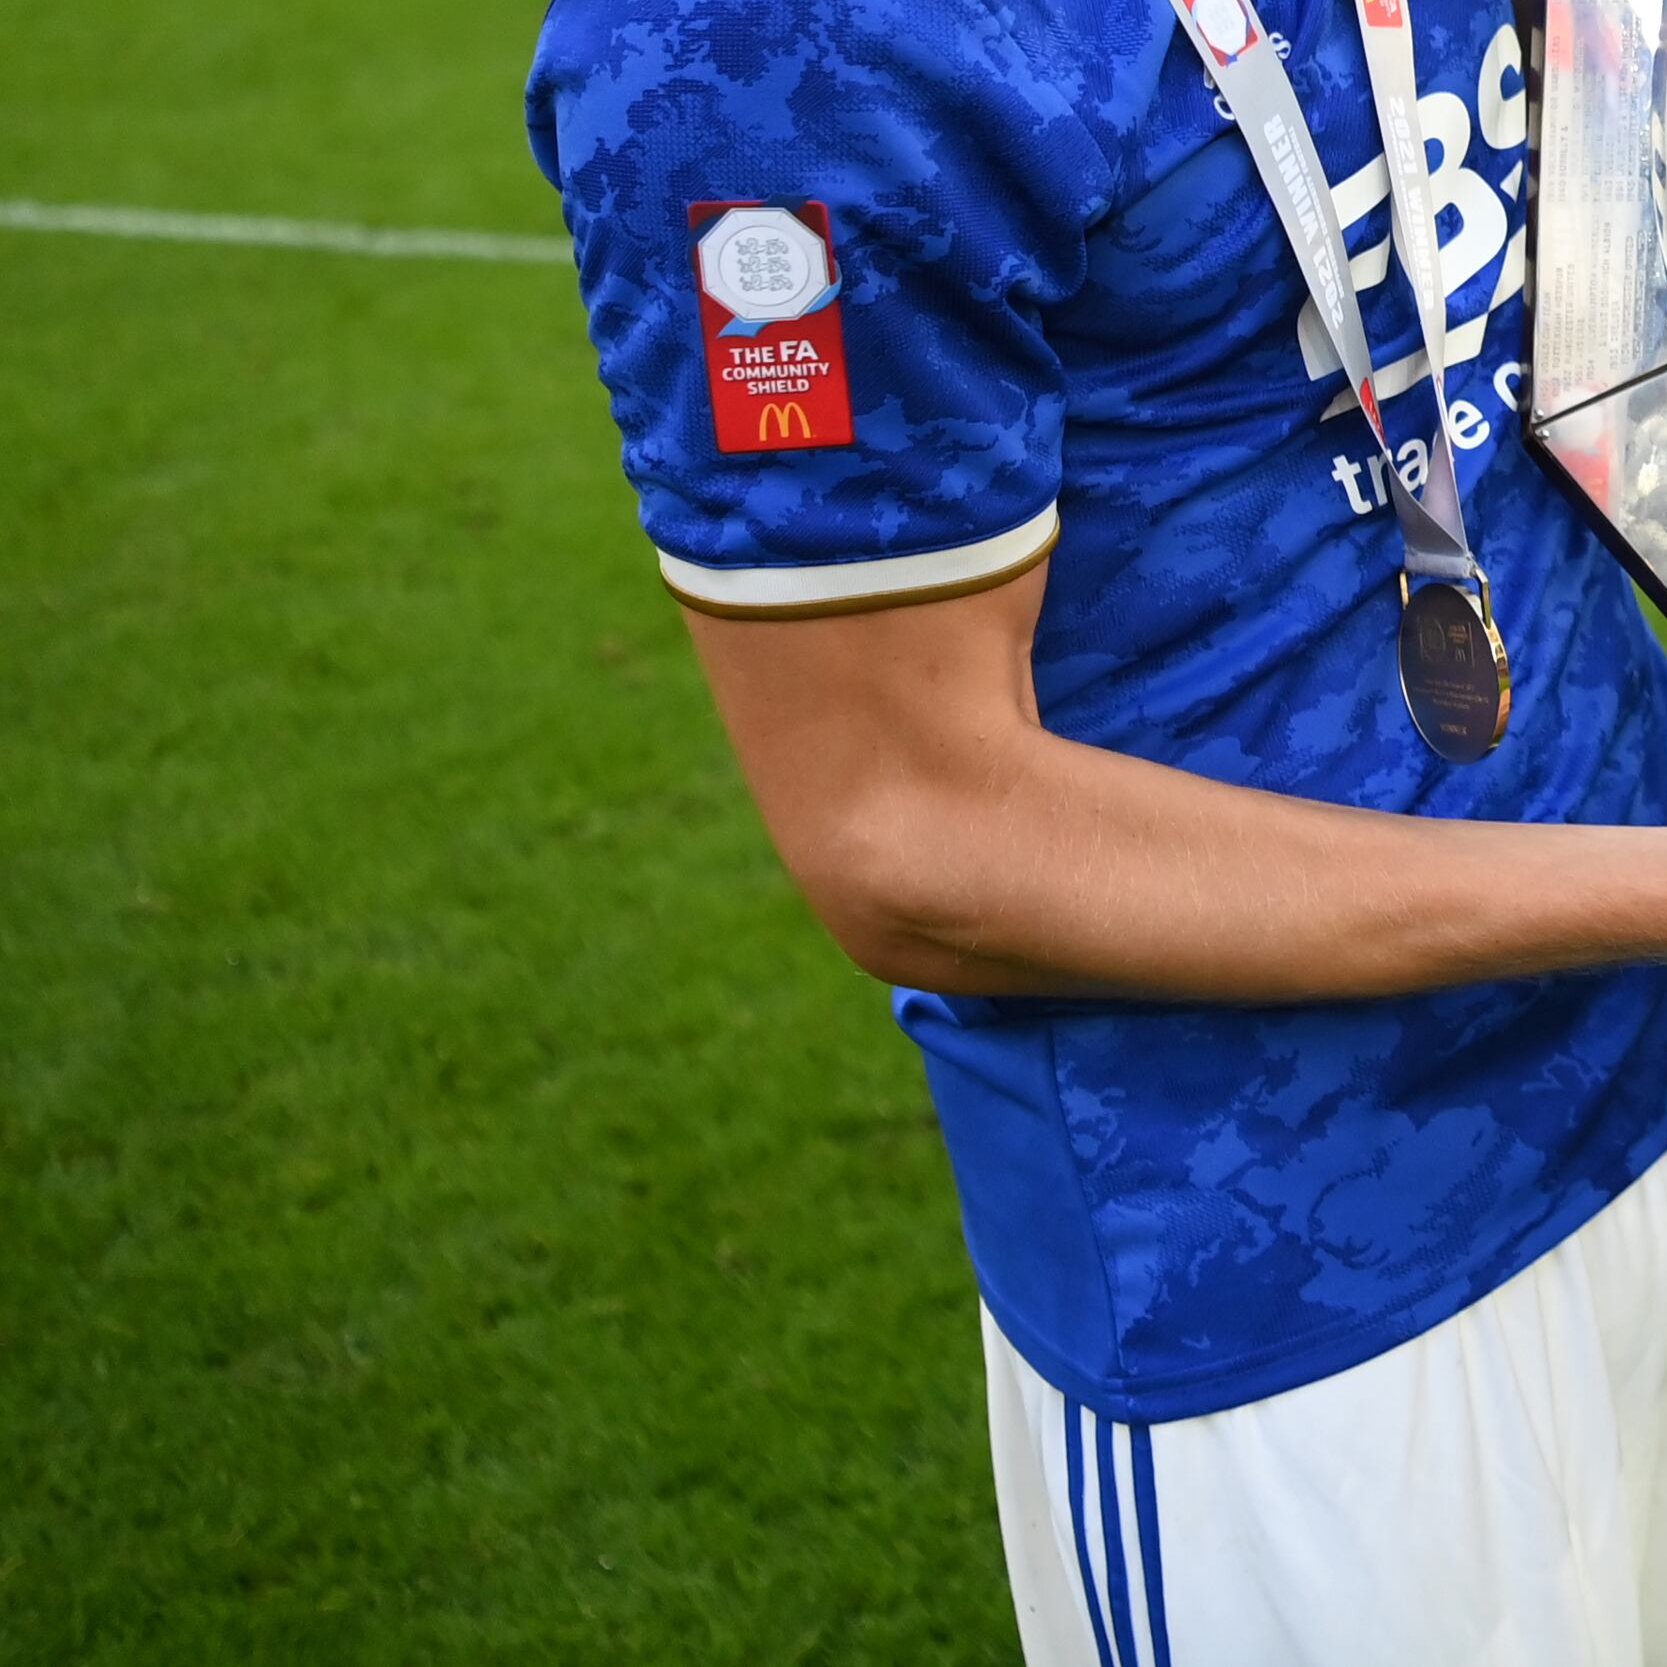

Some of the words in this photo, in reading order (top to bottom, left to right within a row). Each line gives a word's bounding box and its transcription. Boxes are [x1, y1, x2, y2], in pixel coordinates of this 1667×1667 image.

[1263, 113, 1317, 245] WINNER
[1388, 95, 1417, 175] 2021
[1408, 183, 1434, 312] WINNER
[1312, 246, 1345, 329] 2021
[722, 362, 830, 382] COMMUNITY
[729, 347, 774, 365] THE
[779, 340, 819, 362] FA
[747, 379, 810, 396] SHIELD
[1331, 400, 1491, 516] trae
